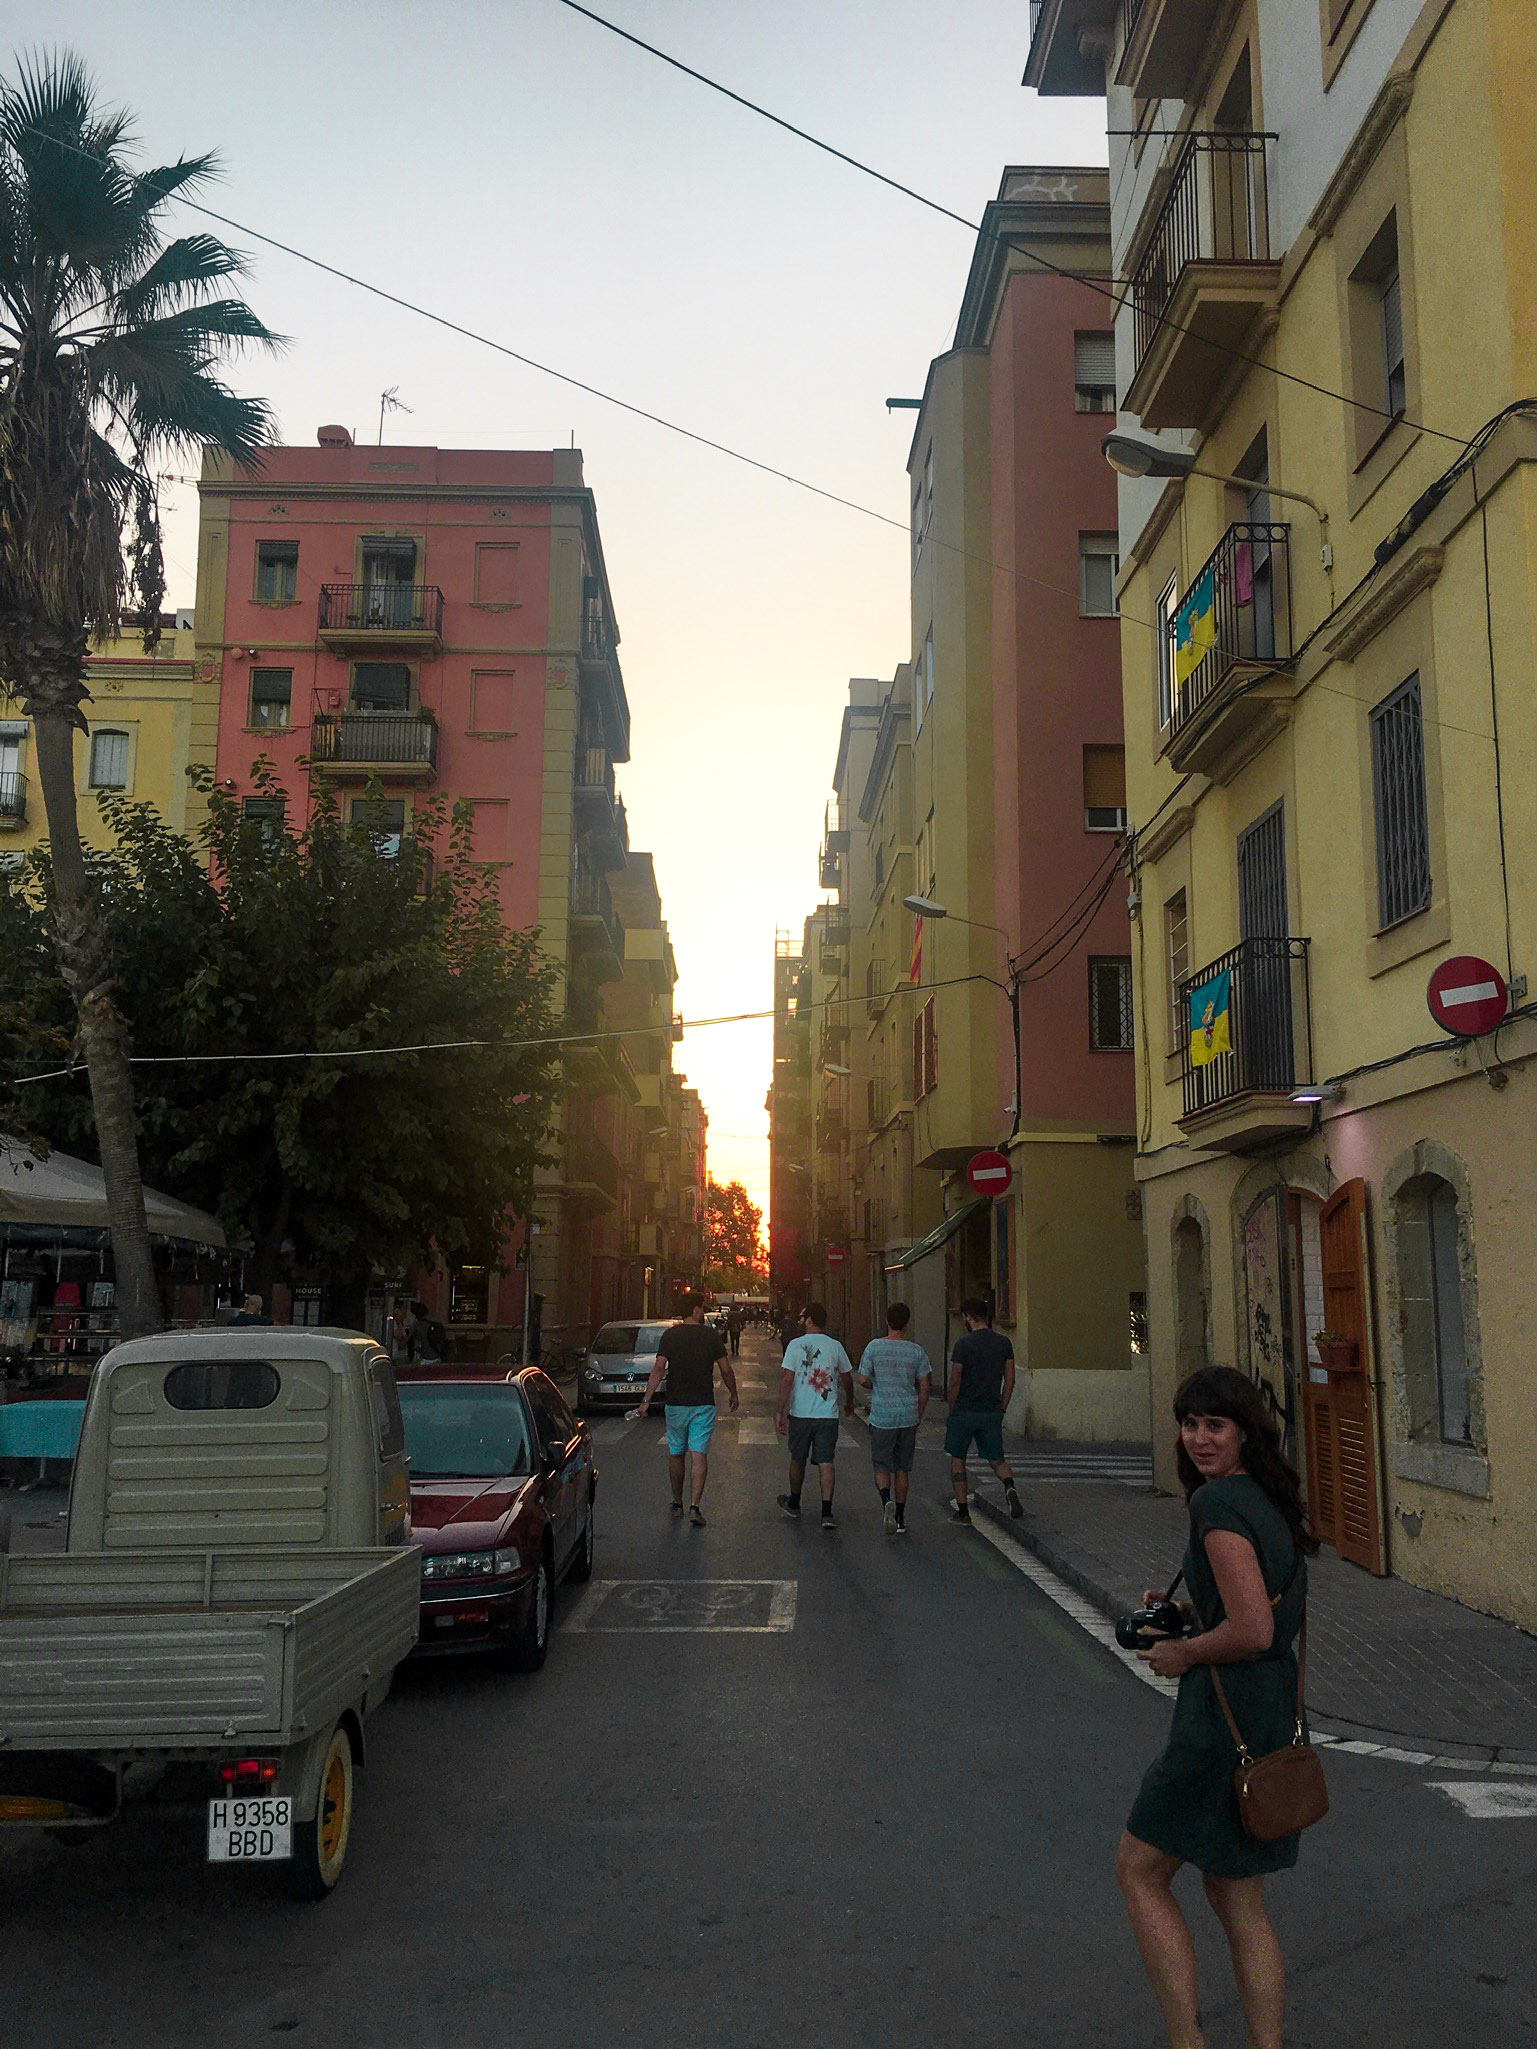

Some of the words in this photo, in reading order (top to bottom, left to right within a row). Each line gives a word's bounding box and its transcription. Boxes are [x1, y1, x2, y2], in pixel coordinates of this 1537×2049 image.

[295, 1287, 322, 1295] HOUSE
[213, 1803, 227, 1828] H
[233, 1800, 289, 1827] 9358
[228, 1830, 274, 1857] BBD
